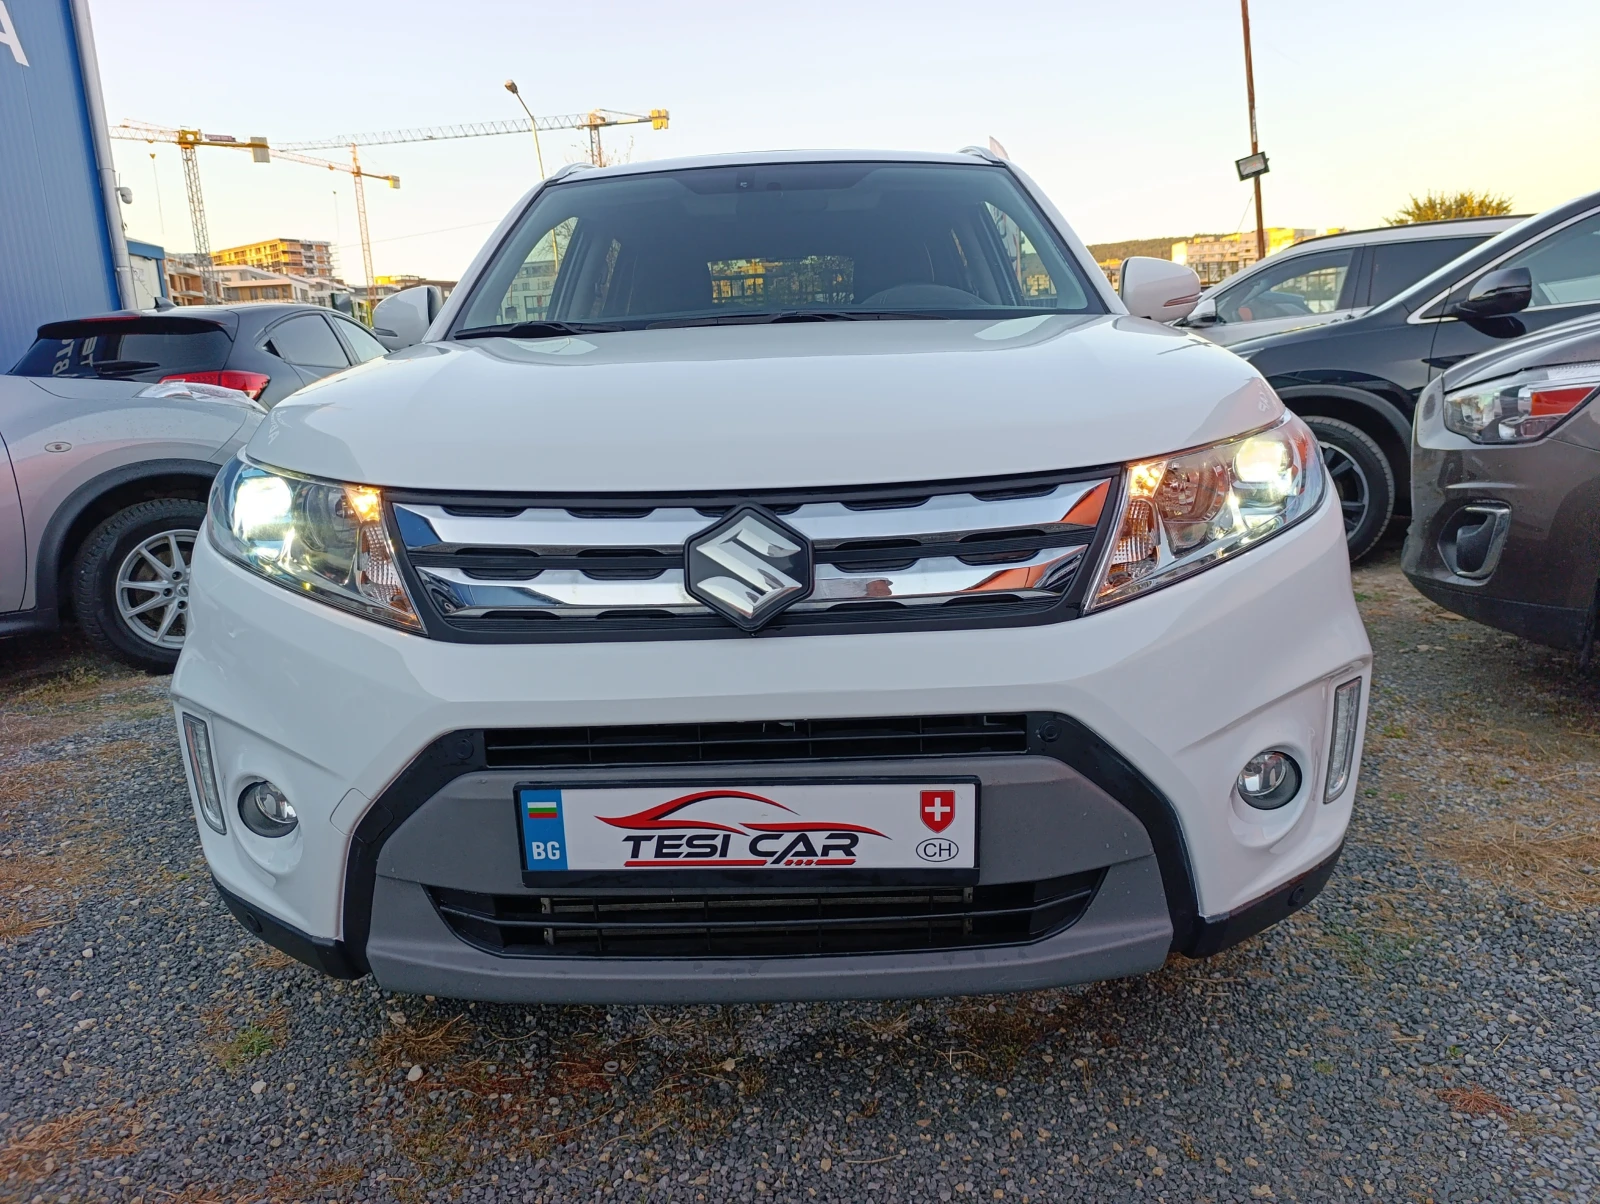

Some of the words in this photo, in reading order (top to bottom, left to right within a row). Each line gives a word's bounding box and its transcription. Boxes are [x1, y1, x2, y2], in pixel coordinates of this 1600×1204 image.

[531, 841, 560, 860] BG
[621, 833, 731, 858] TESI
[748, 832, 859, 865] CAR
[923, 842, 952, 857] CH
